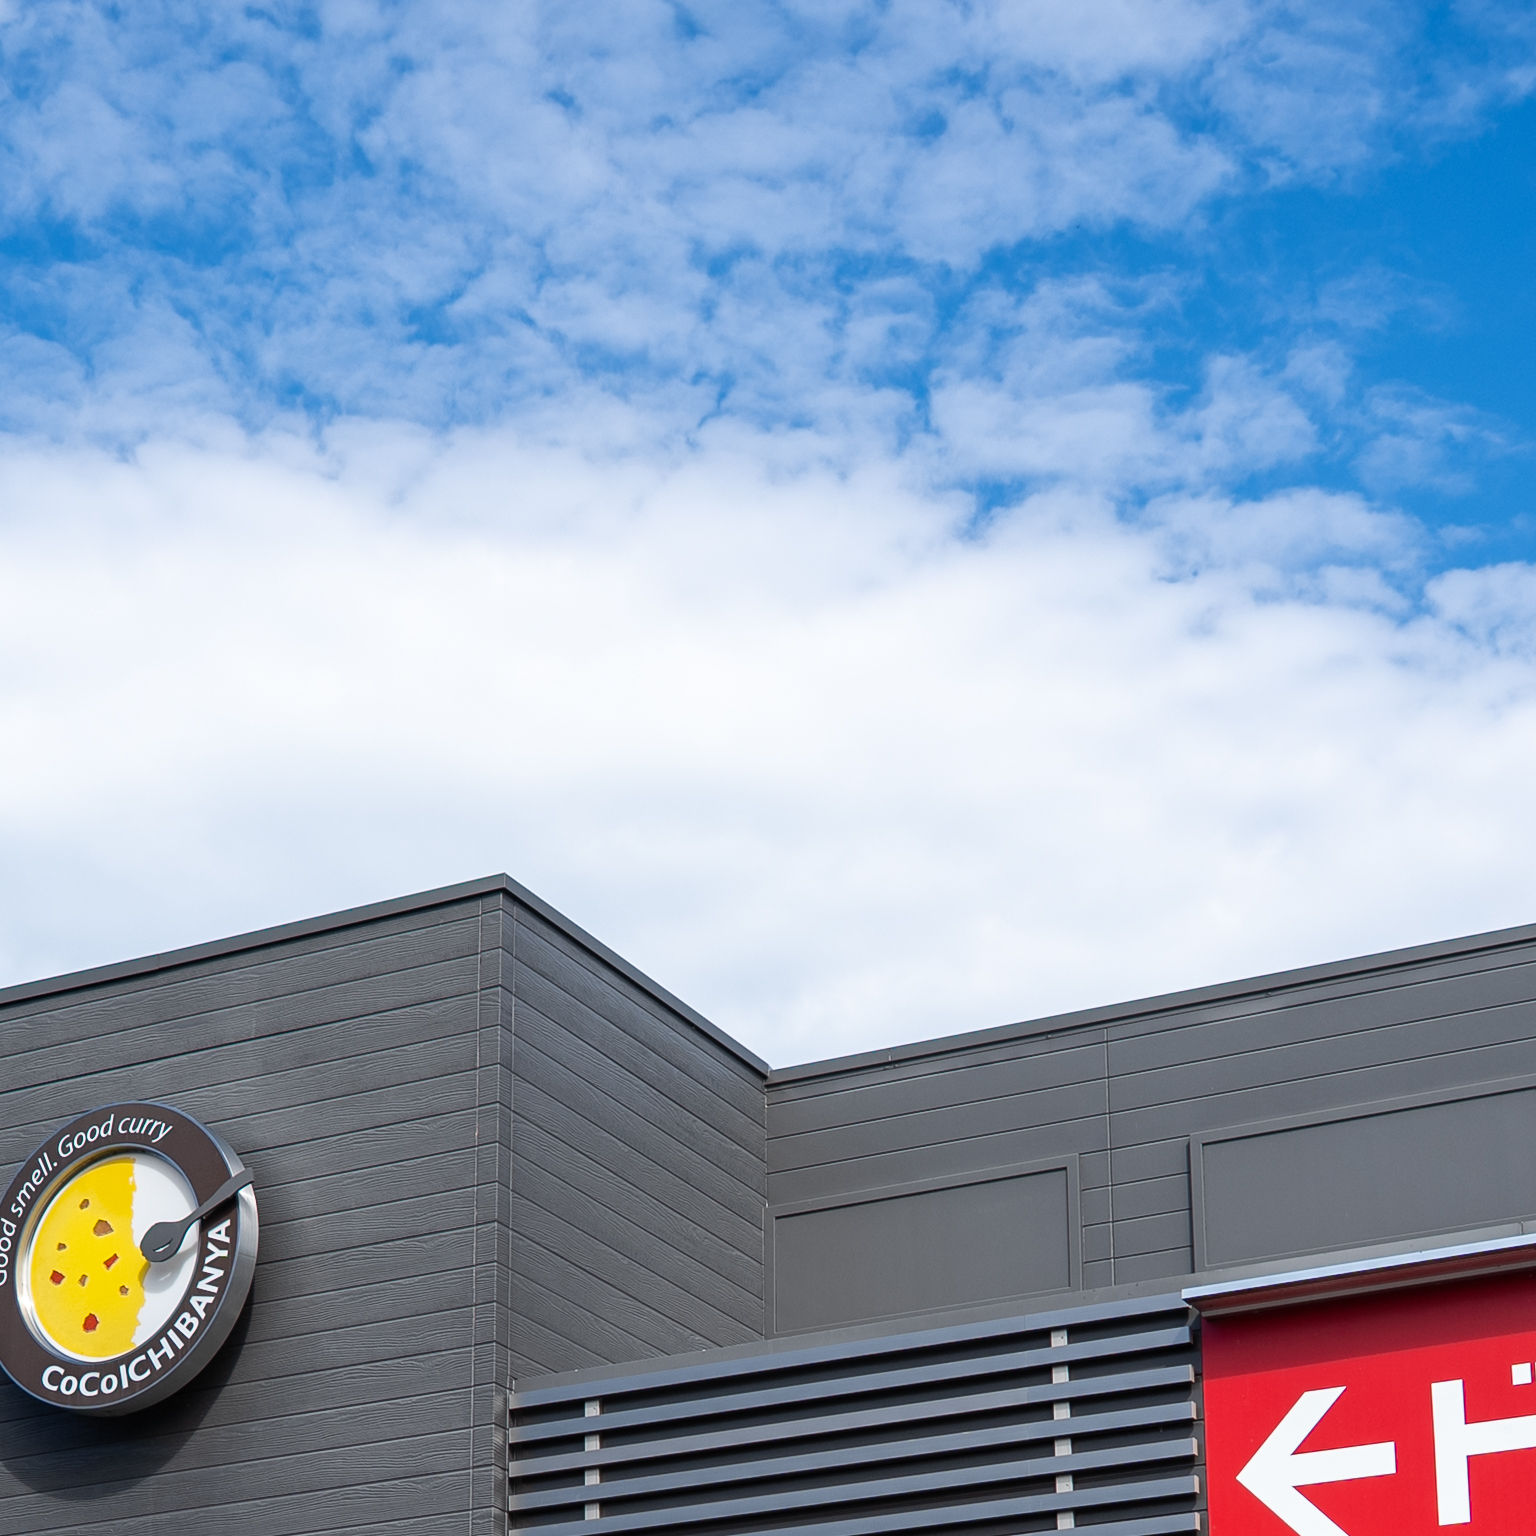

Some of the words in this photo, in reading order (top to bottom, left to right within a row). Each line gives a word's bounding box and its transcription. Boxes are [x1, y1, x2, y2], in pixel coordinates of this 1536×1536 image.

[11, 1152, 58, 1217] smell.
[57, 1114, 114, 1158] Good
[118, 1117, 173, 1143] curry
[41, 1219, 231, 1397] CoCoICHIBANYA
